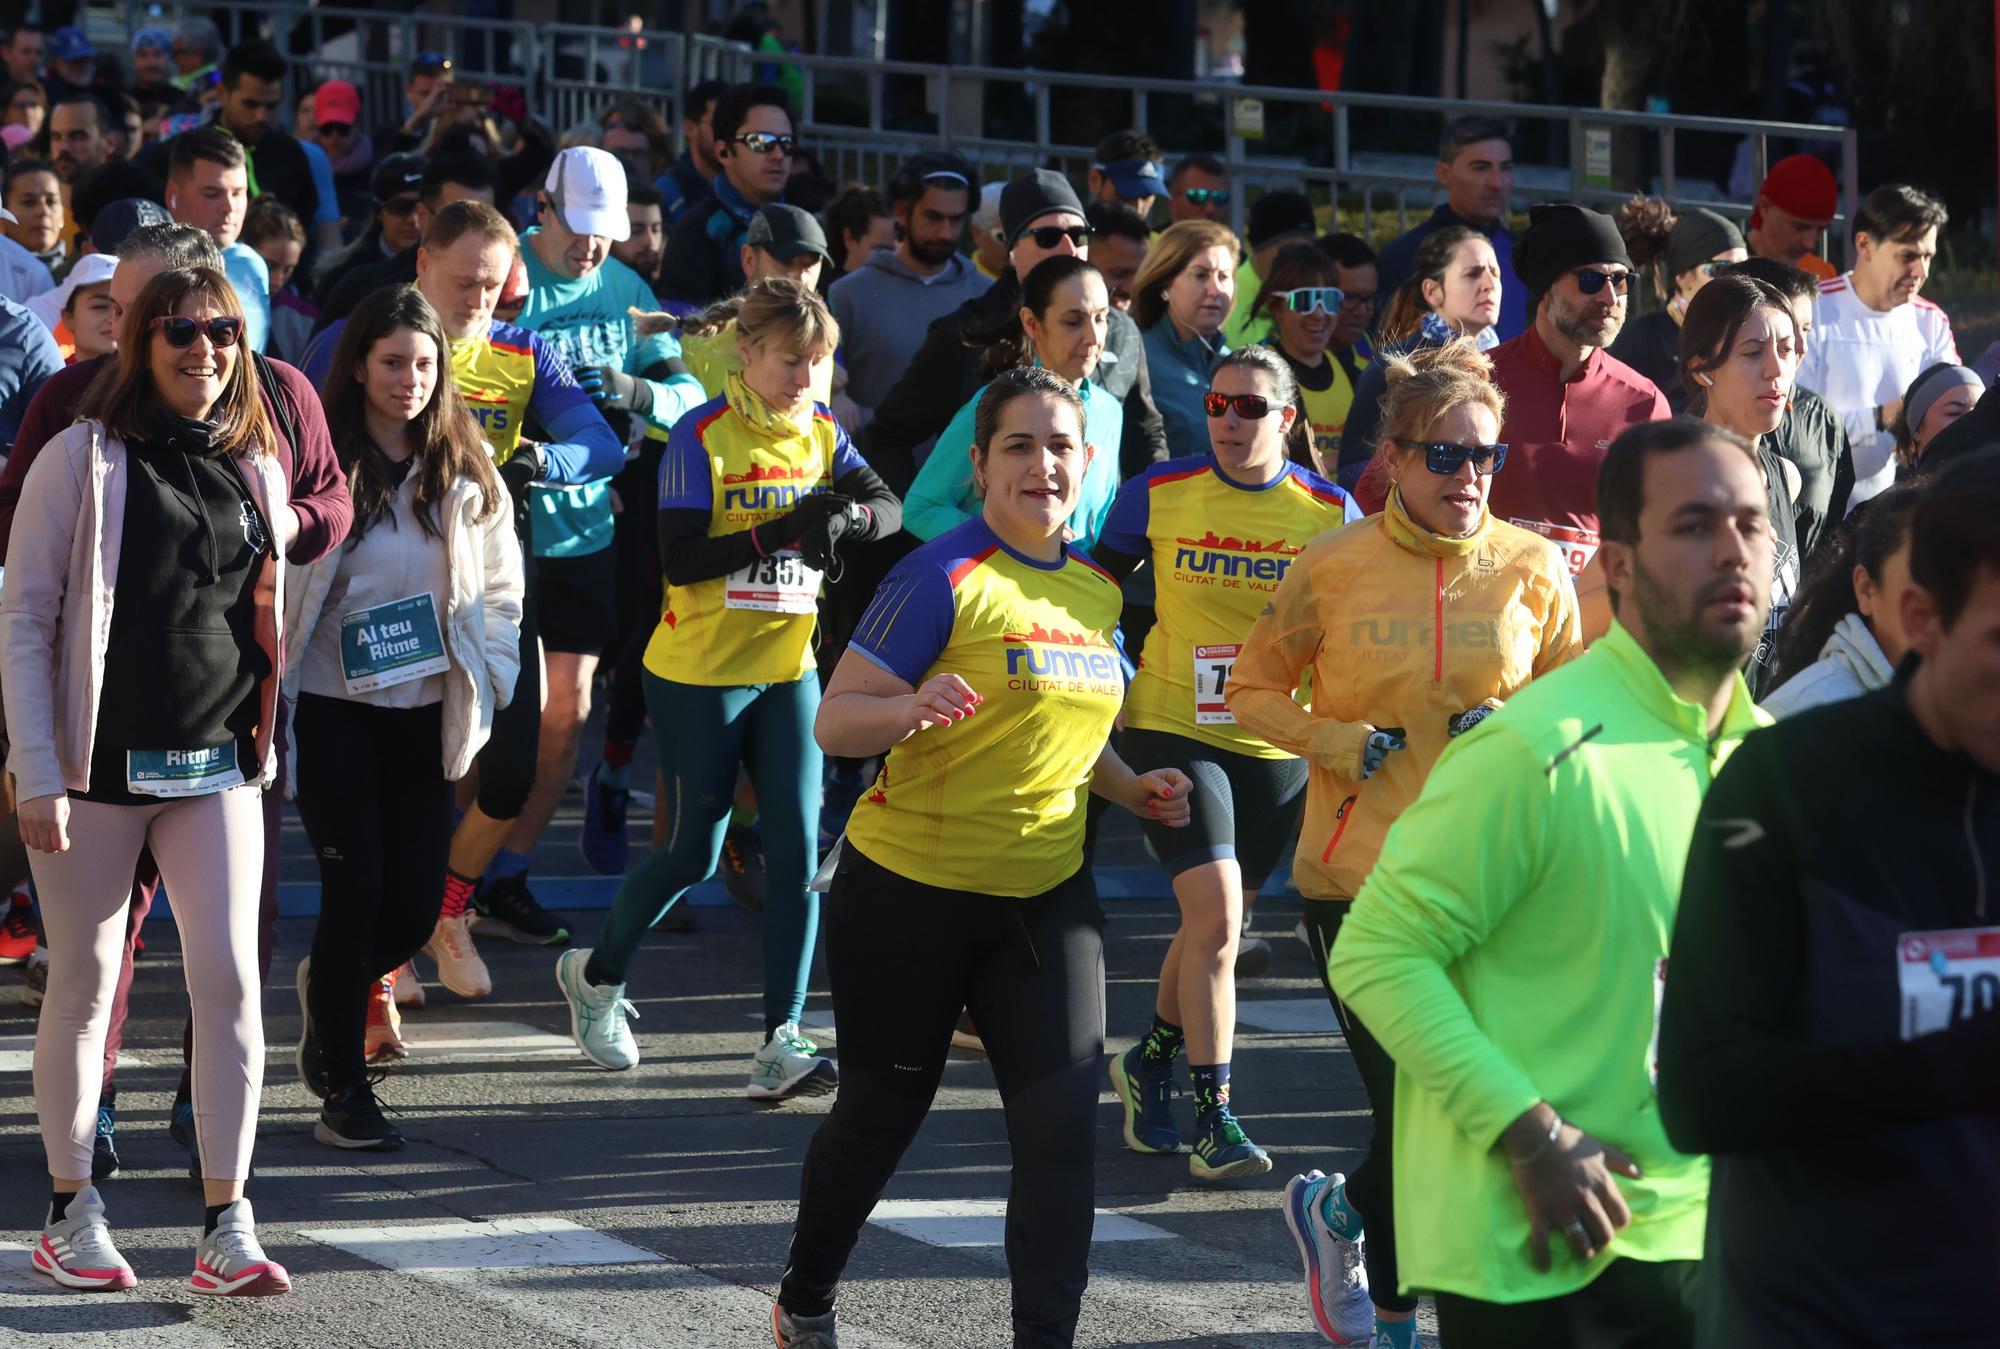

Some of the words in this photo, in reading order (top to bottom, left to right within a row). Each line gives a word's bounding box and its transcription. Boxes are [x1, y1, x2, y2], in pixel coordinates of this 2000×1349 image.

[726, 512, 768, 522] CIUTAT
[1562, 548, 1586, 575] 9
[1174, 571, 1216, 586] CIUTAT
[1222, 578, 1240, 588] DE
[357, 625, 378, 647] Al
[380, 620, 413, 638] teu
[369, 637, 420, 660] Ritme
[1008, 680, 1061, 691] CIUTAT
[1068, 682, 1084, 692] DE
[1211, 664, 1233, 695] 7
[166, 747, 220, 766] Ritme
